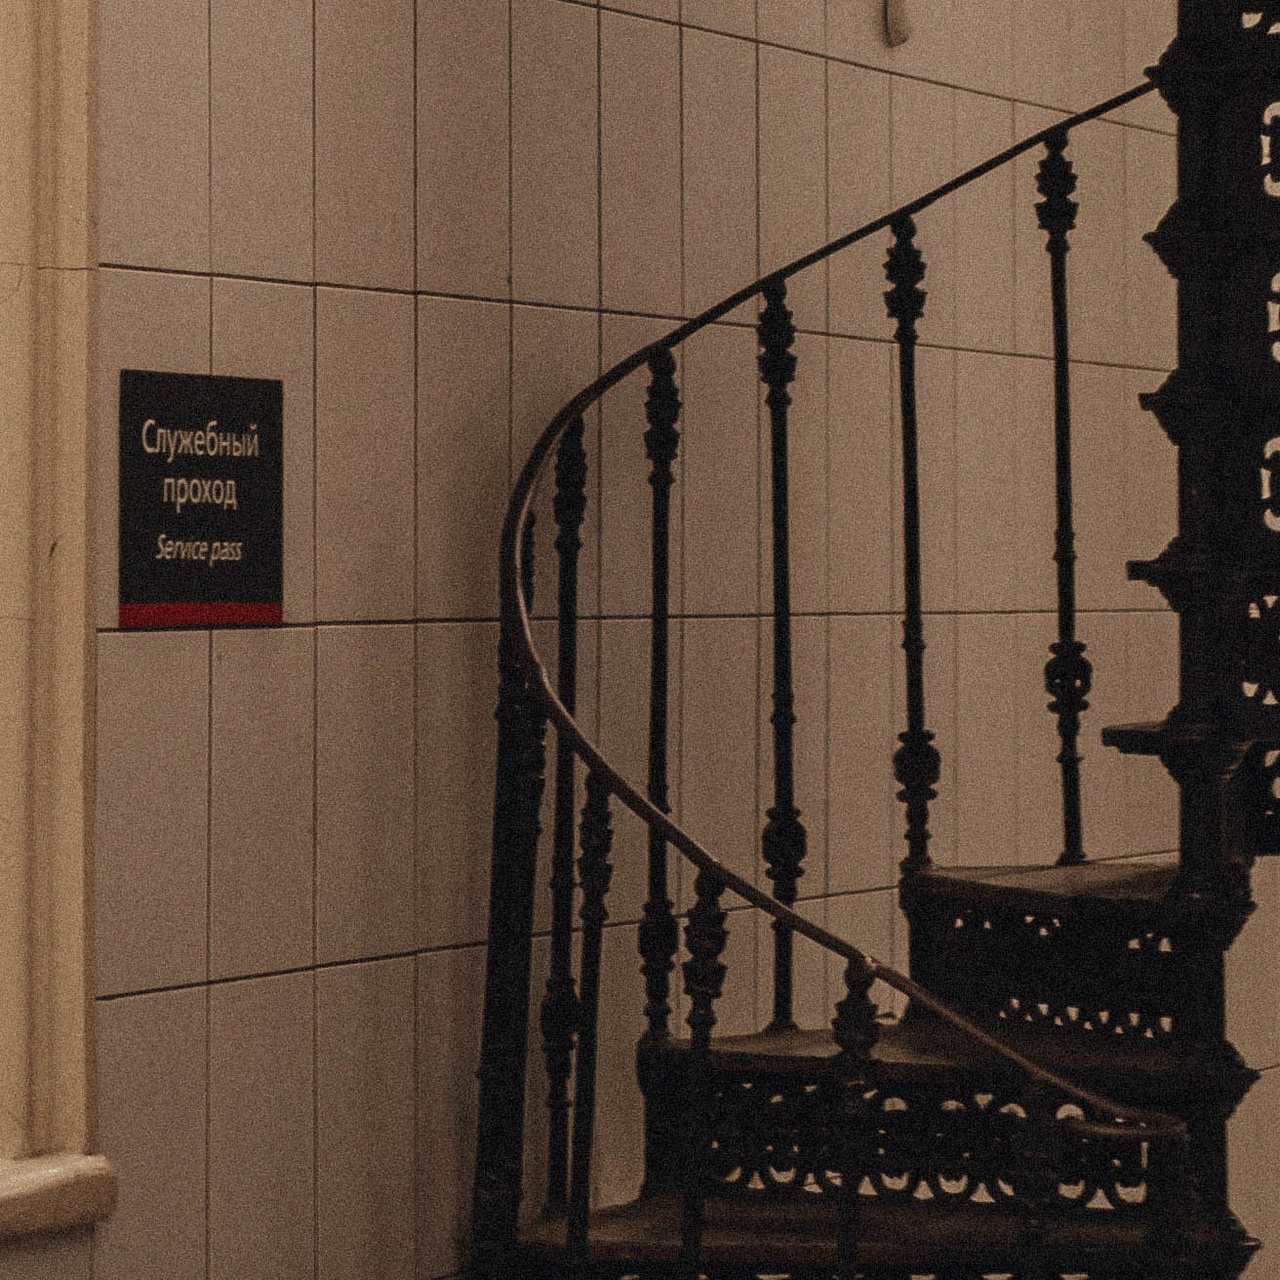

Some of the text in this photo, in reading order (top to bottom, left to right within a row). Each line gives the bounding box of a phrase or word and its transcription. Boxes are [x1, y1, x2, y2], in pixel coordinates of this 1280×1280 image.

[141, 419, 259, 463] Служебный
[163, 477, 237, 513] проход
[155, 534, 243, 566] Service pass
